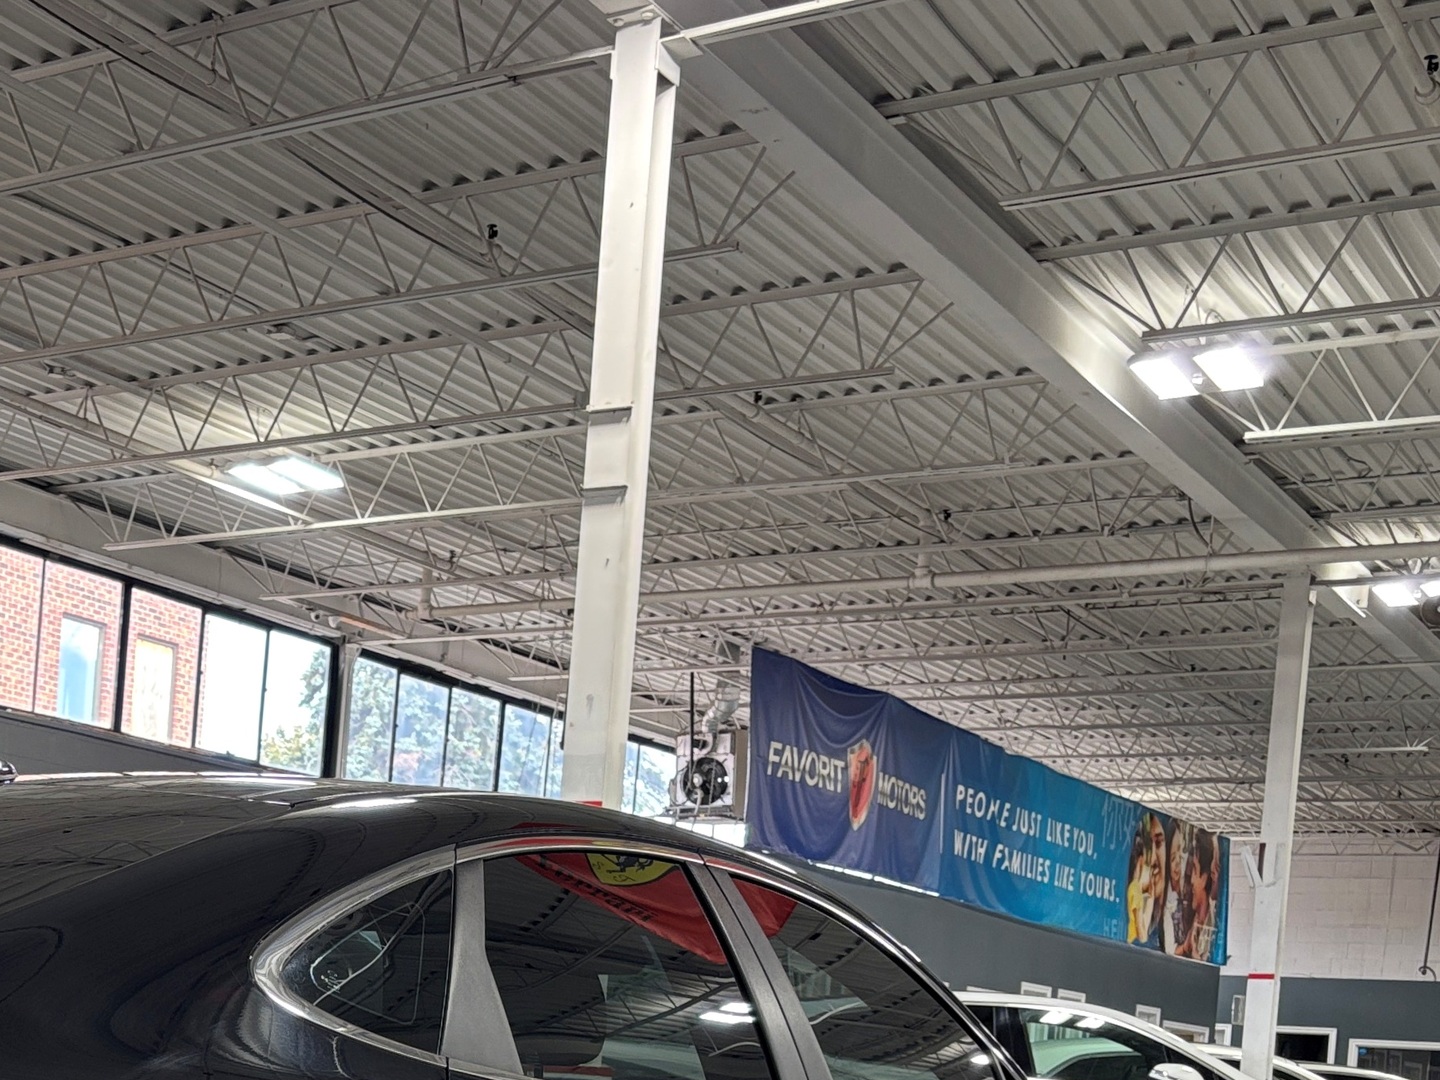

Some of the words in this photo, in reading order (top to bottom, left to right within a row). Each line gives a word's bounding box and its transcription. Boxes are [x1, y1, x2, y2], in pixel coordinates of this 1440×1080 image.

[766, 740, 846, 794] FAVORIT
[876, 771, 927, 821] MOTORS
[1011, 806, 1042, 838] JUST
[1046, 817, 1071, 848] LIKE
[953, 829, 988, 865] WITH
[1054, 862, 1075, 892] LIKE
[1079, 870, 1120, 904] YOURS.
